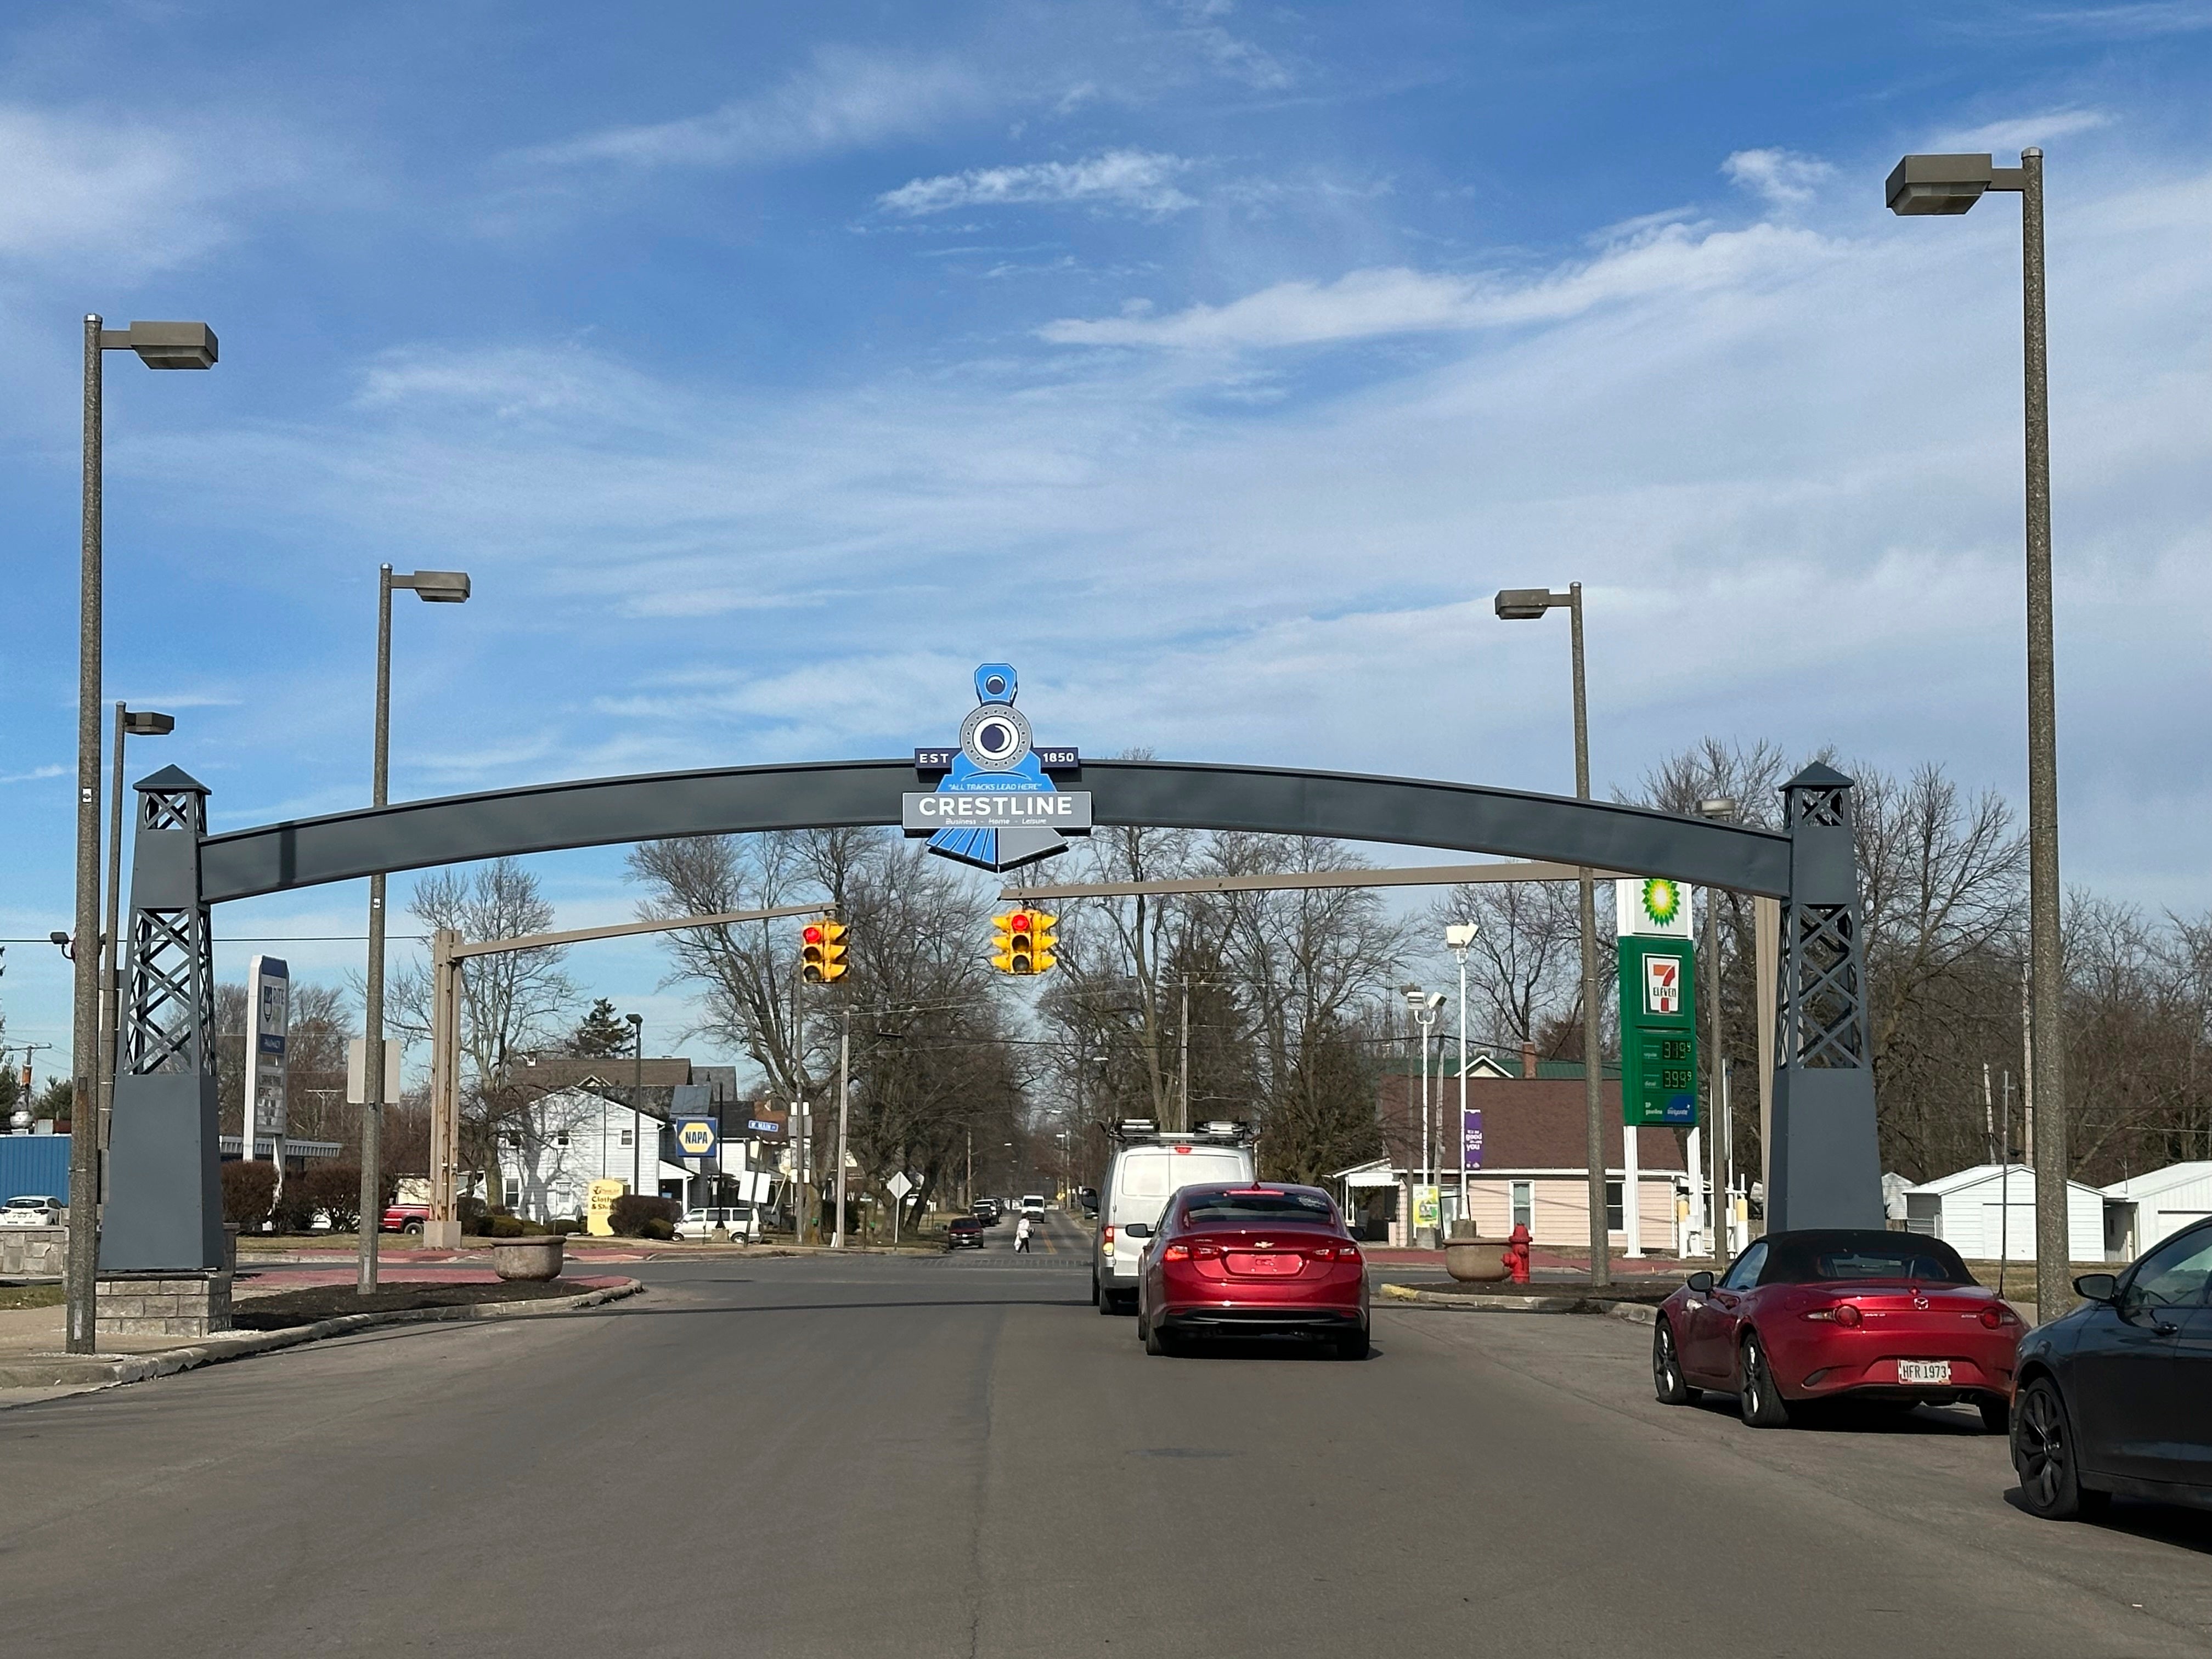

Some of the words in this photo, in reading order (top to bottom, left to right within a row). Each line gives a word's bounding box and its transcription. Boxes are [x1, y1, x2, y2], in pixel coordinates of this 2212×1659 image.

[919, 753, 949, 763] EST
[1043, 752, 1074, 763] 1850
[918, 796, 1073, 816] CRESTLINE
[685, 1131, 708, 1144] NAPA
[1465, 1132, 1482, 1141] good
[1903, 1365, 1921, 1379] HFR
[1923, 1365, 1947, 1379] 1973
